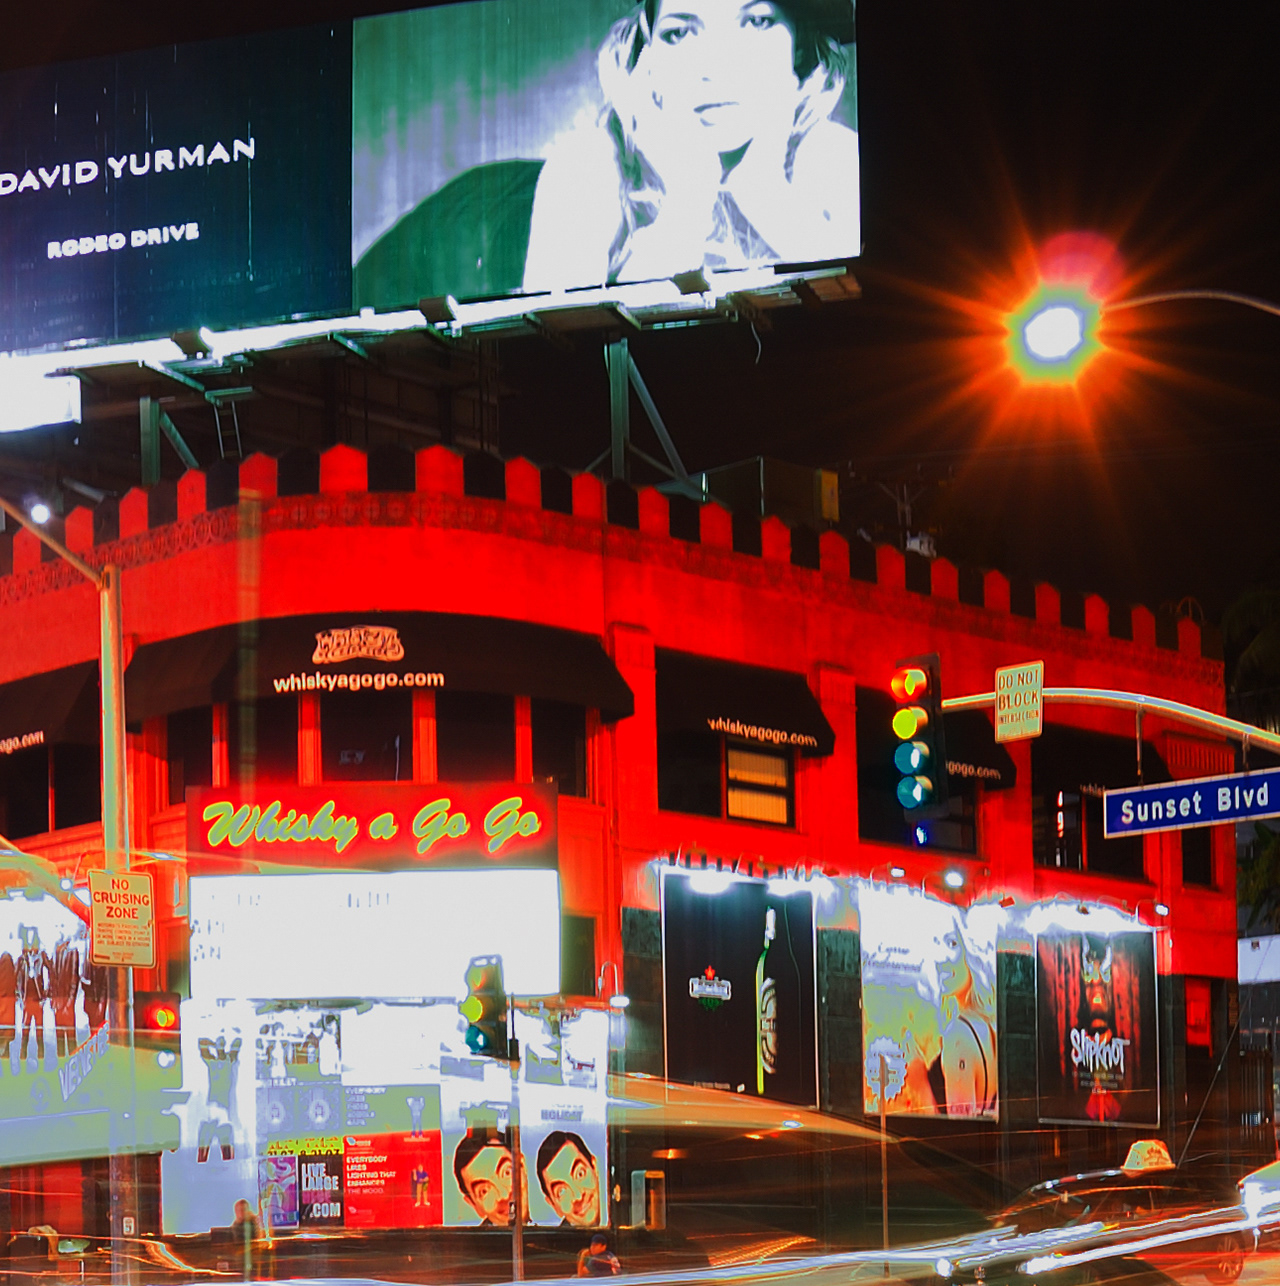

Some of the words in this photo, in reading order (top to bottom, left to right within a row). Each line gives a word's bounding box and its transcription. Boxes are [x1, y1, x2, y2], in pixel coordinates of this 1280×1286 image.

[107, 137, 255, 179] YURMAN
[47, 232, 126, 259] RODEO
[131, 222, 199, 247] DRIVE
[273, 671, 445, 693] whiskyagogo.com
[998, 673, 1014, 691] DO
[1017, 669, 1039, 687] NOT
[998, 690, 1039, 712] BLOCK
[706, 716, 817, 748] whiskyagogo.com
[1122, 790, 1202, 824] Sunset
[1218, 782, 1269, 812] Blvd
[203, 800, 358, 853] Whisky
[369, 813, 398, 839] a
[412, 798, 470, 854] Go
[484, 797, 542, 853] Go
[111, 878, 129, 890] NO
[93, 891, 150, 906] CRUISING
[106, 906, 139, 919] ZONE
[301, 1162, 326, 1177] LIVE
